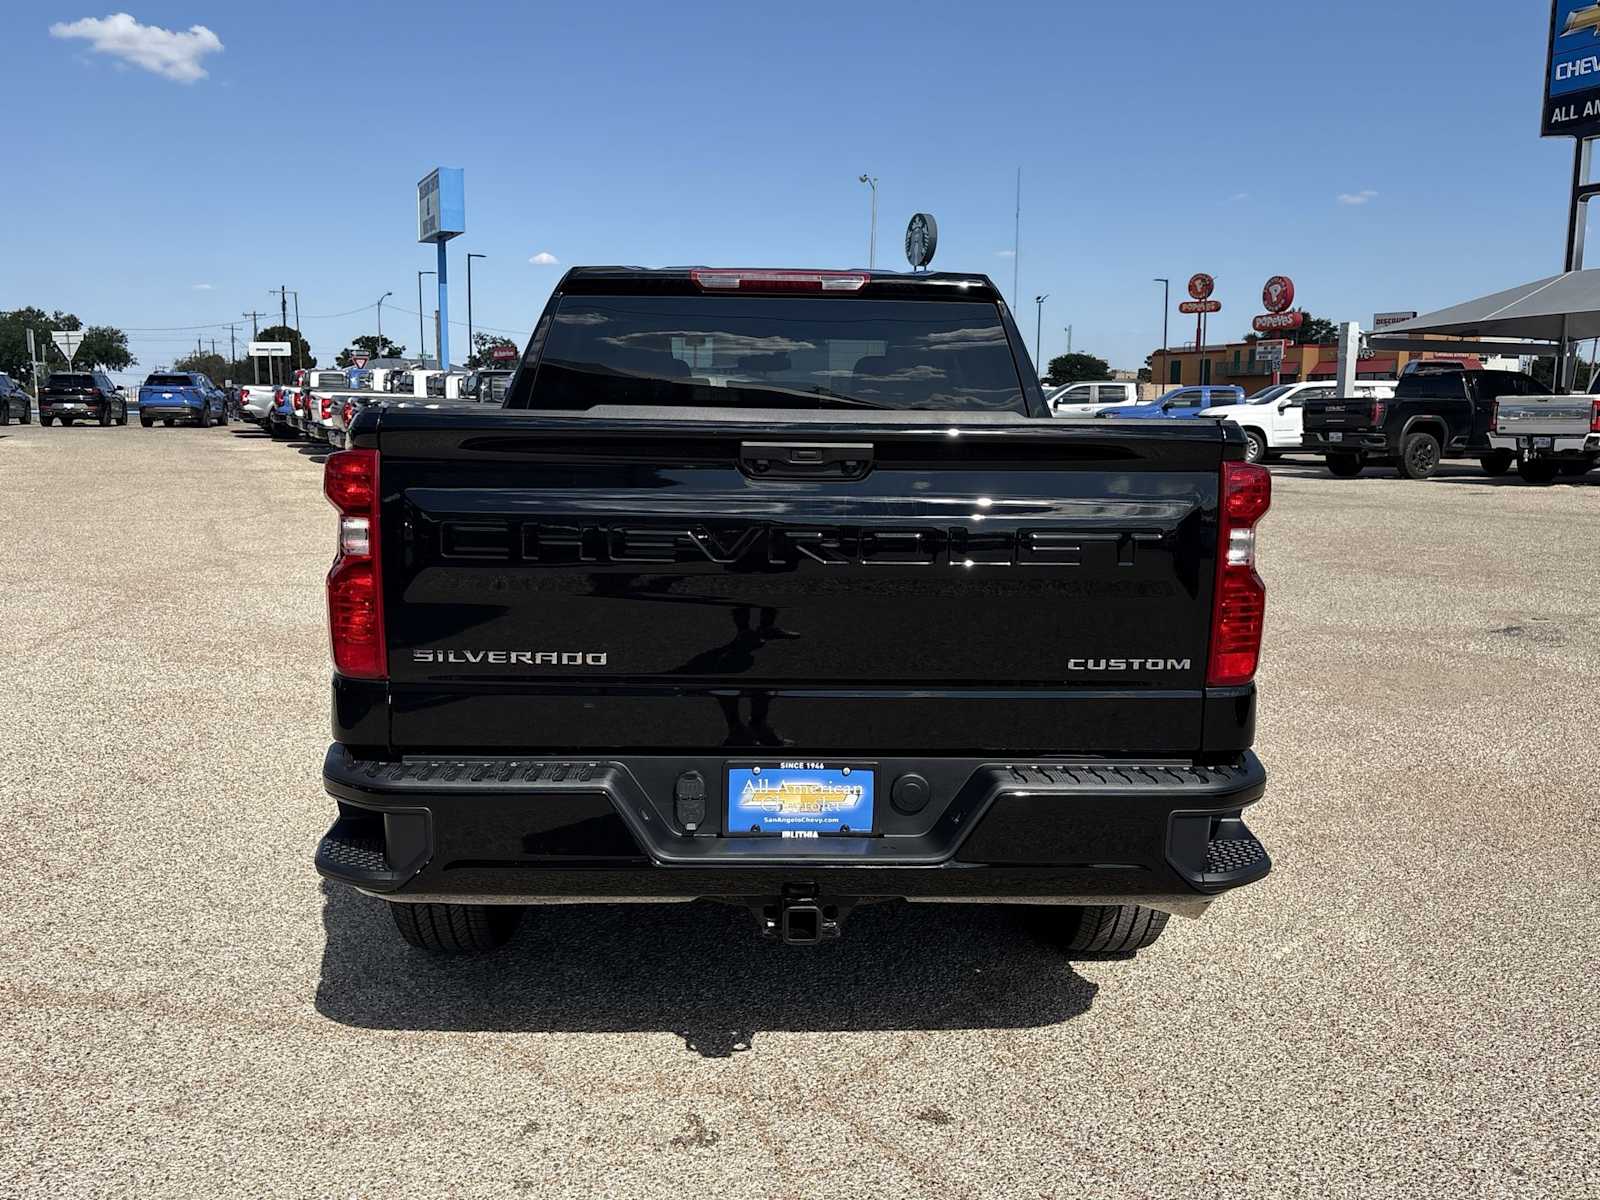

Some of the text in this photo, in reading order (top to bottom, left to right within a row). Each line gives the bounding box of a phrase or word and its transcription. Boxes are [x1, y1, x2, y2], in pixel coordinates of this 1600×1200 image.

[1551, 104, 1579, 124] ALL
[440, 520, 1164, 567] CHEVROLET
[412, 648, 608, 667] SILVERADO
[1066, 658, 1192, 671] CUSTOM
[741, 778, 864, 795] All American
[763, 816, 840, 824] SanAngeloChevy.com
